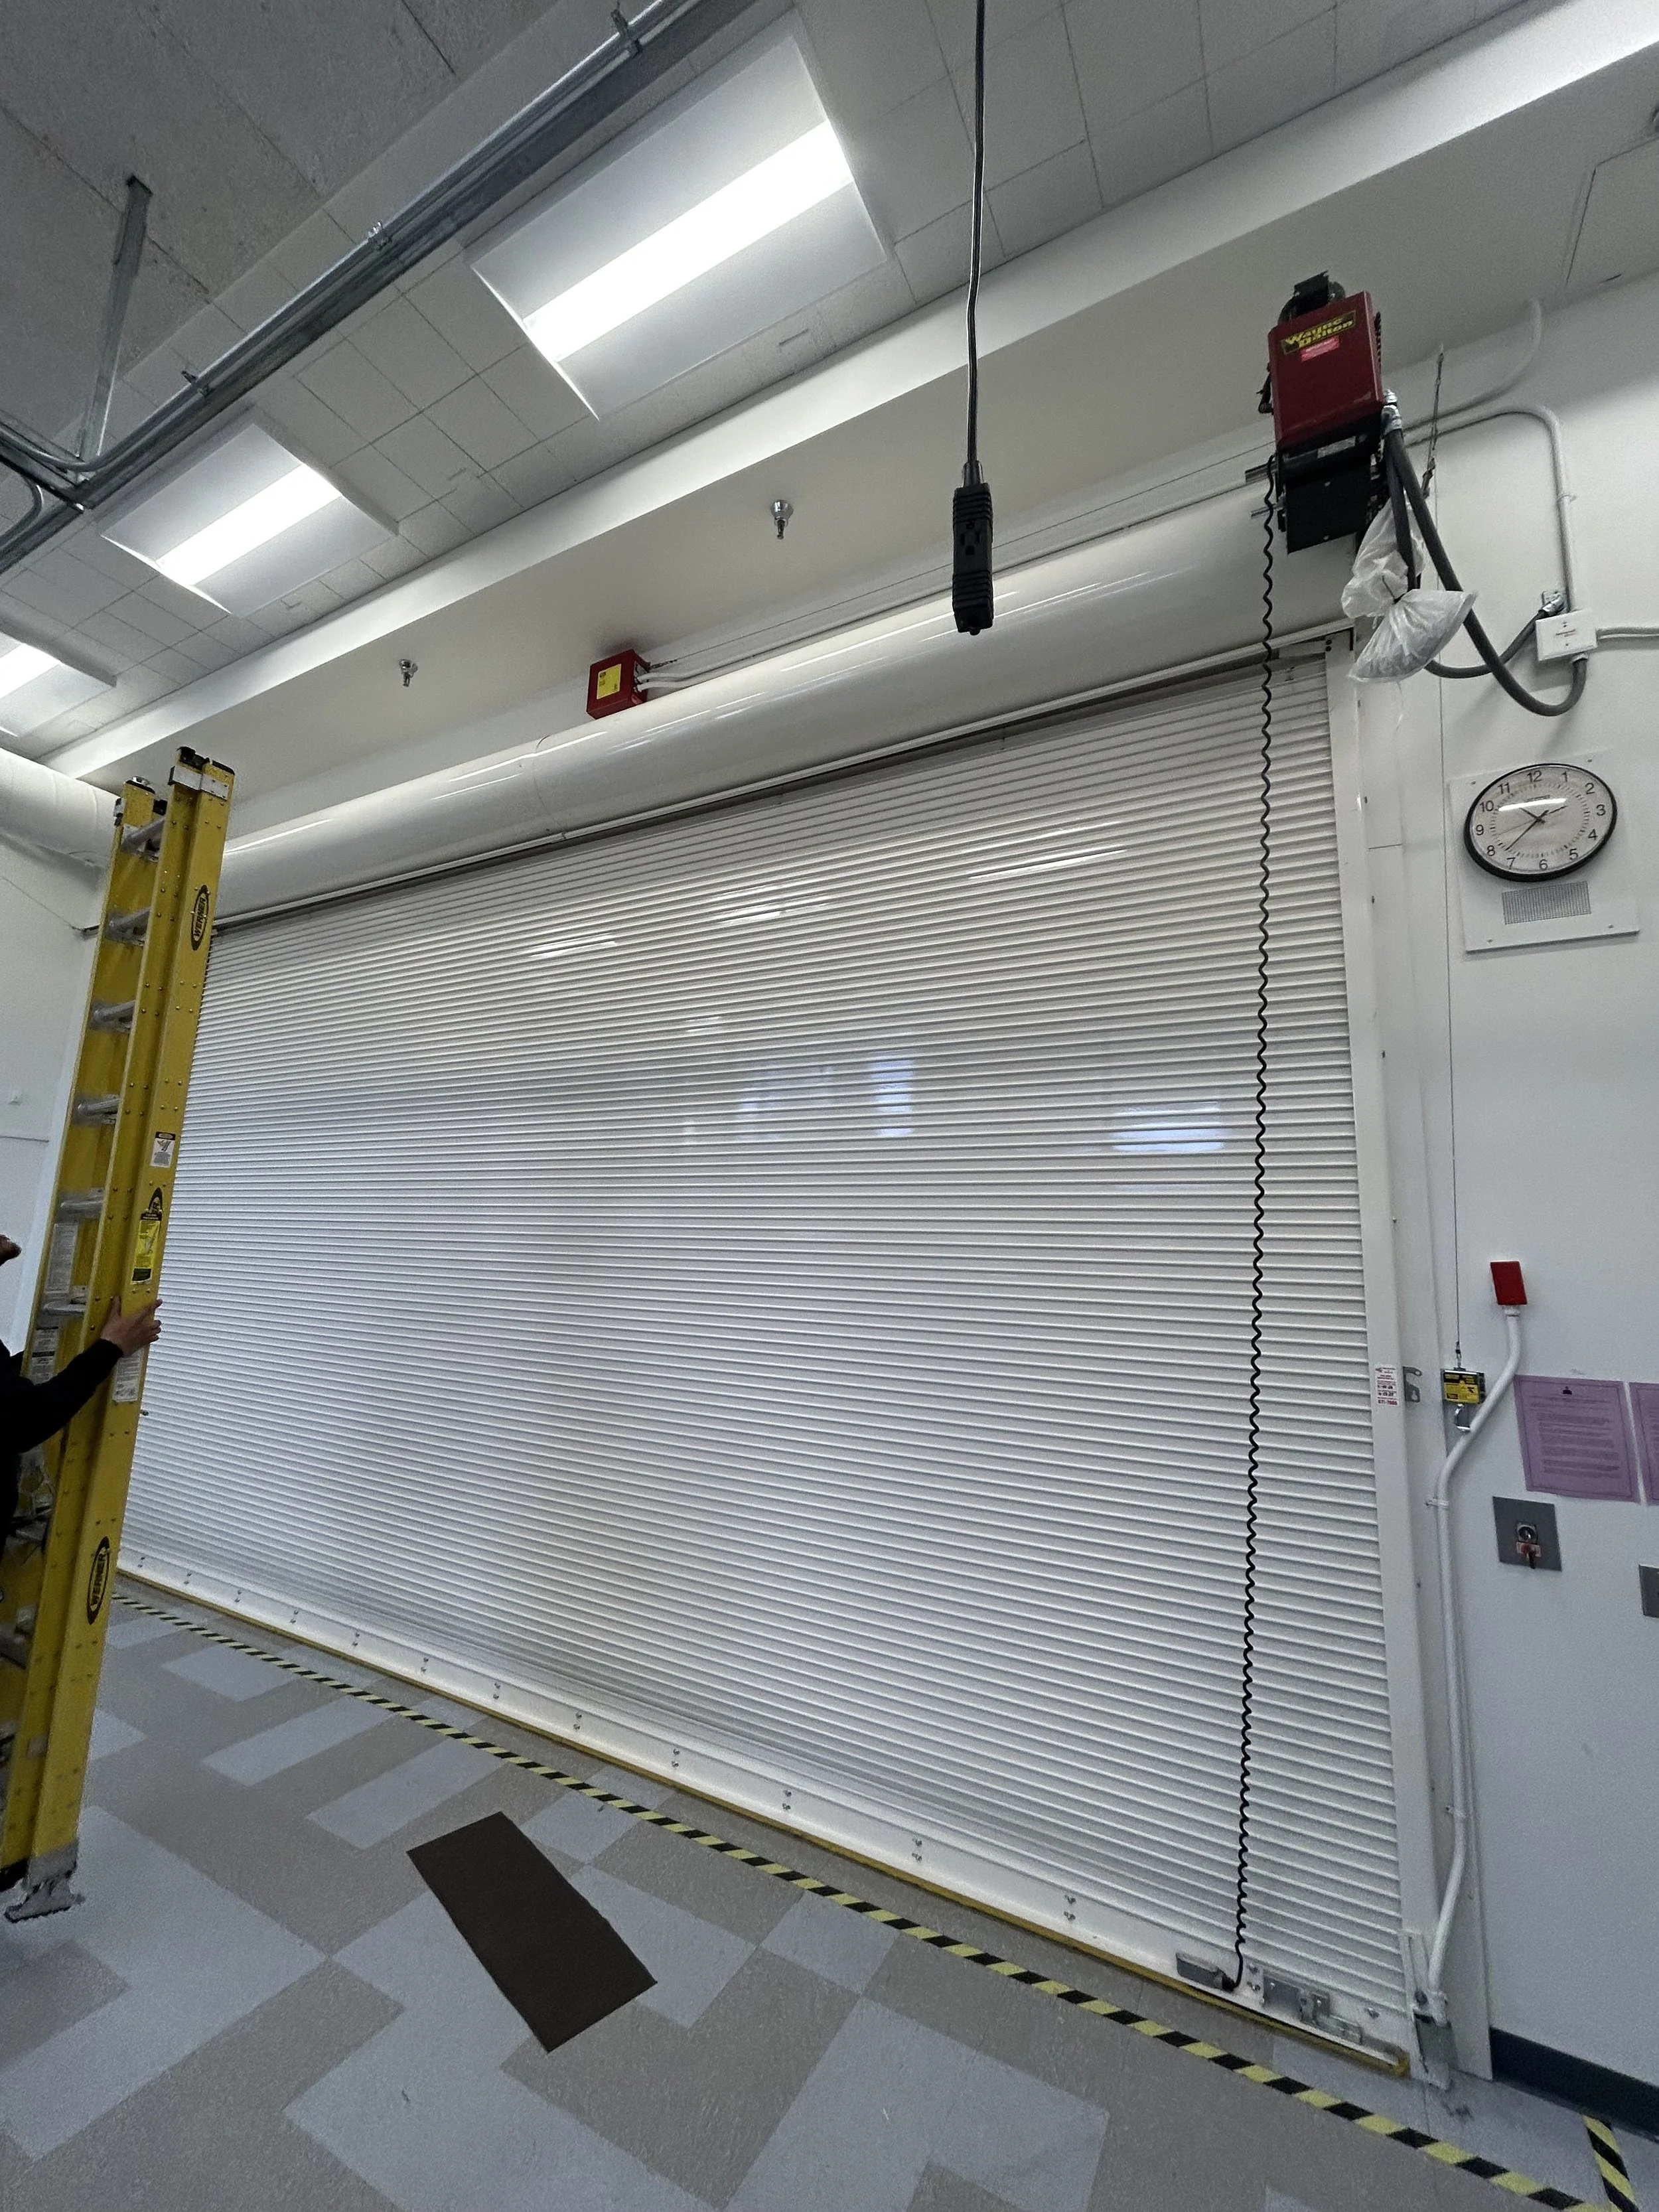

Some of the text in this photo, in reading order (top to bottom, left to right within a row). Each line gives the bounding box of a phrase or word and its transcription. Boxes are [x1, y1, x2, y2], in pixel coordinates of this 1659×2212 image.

[1527, 770, 1542, 783] 12
[1561, 771, 1568, 782] 1
[1498, 782, 1511, 794] 11
[1585, 782, 1595, 795] 2
[1479, 800, 1494, 813] 10
[1596, 804, 1606, 816] 3
[1476, 824, 1484, 836] 9
[1587, 829, 1598, 840] 4
[1486, 845, 1496, 856] 8
[1569, 848, 1579, 861] 5
[1506, 857, 1516, 869] 7
[1539, 859, 1548, 870] 6
[193, 896, 206, 937] WERNER
